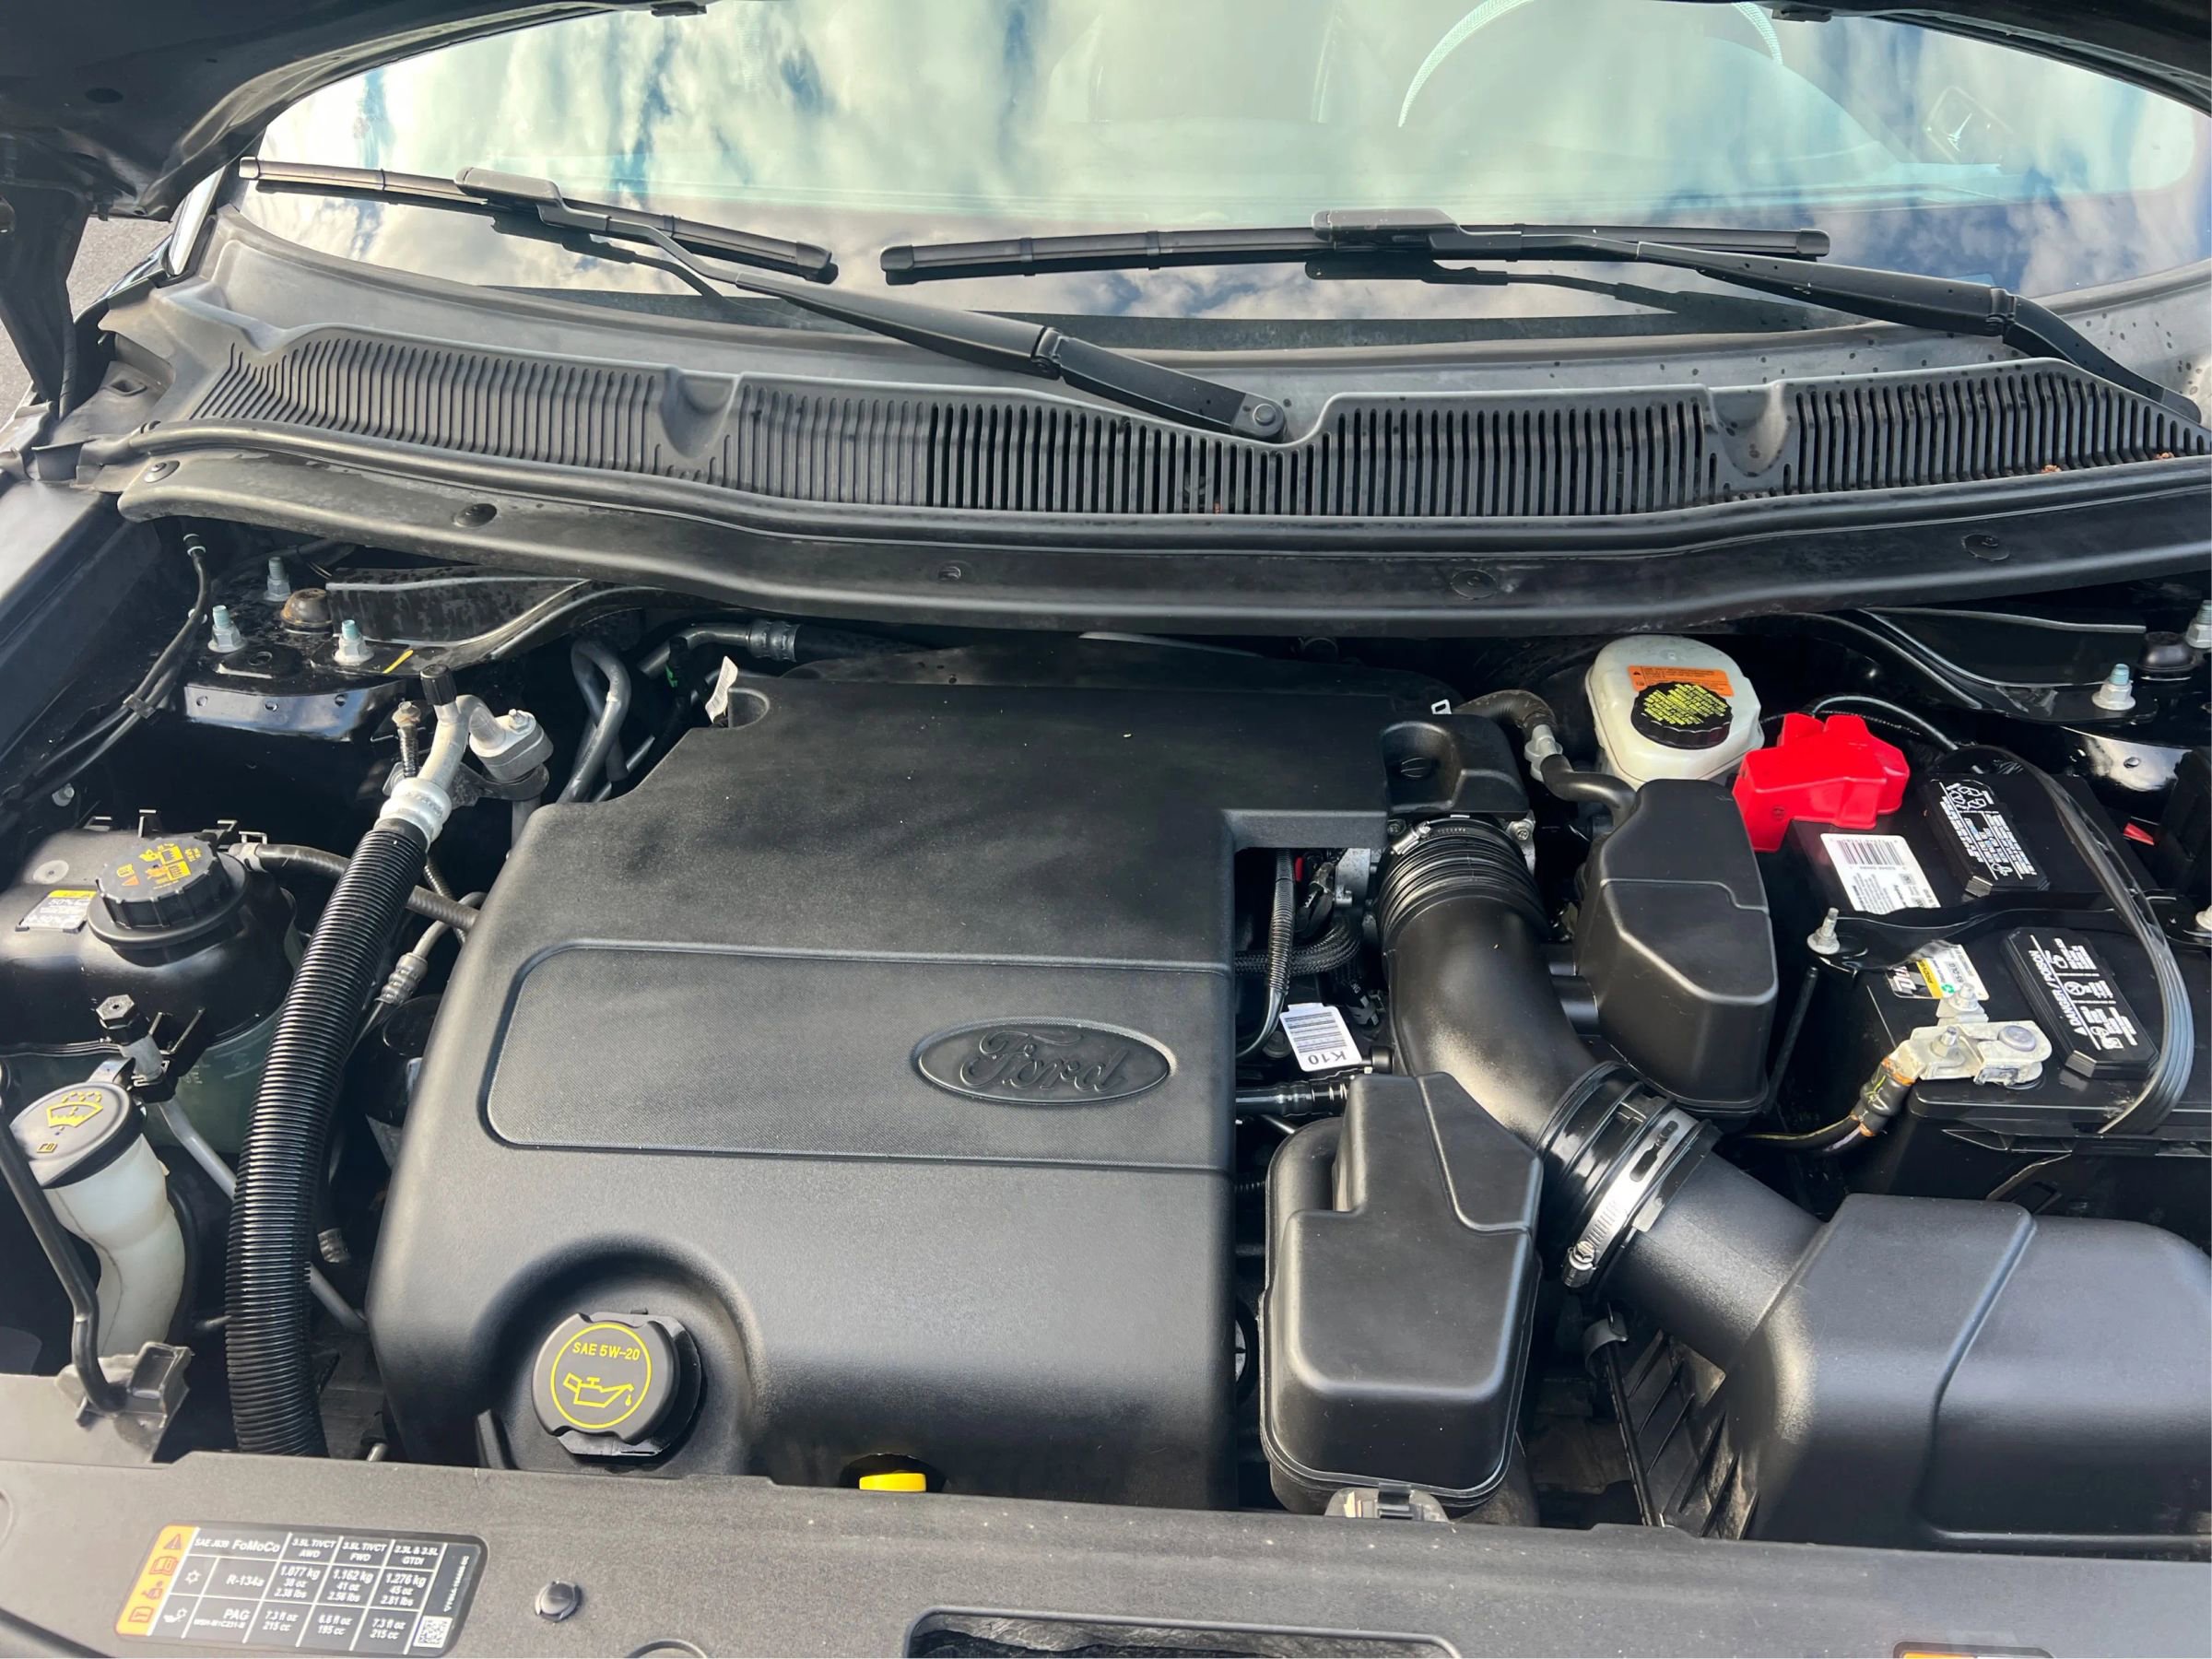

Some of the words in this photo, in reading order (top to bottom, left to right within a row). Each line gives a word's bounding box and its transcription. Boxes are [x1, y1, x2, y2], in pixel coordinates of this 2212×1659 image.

[2029, 950, 2056, 982] POISON
[2052, 989, 2083, 1027] DANGER
[960, 1030, 1130, 1092] Ford
[1308, 1050, 1347, 1065] K10
[572, 1342, 597, 1357] SAE
[599, 1344, 641, 1361] 5W-20
[194, 1538, 212, 1547] SAE
[231, 1539, 281, 1553] FoMoCo
[292, 1538, 310, 1547] 3.5L
[342, 1541, 360, 1550] 3.5L
[298, 1549, 322, 1558] AWD
[349, 1552, 371, 1561] FWD
[280, 1566, 307, 1577] 1.077
[306, 1568, 321, 1581] kg
[333, 1569, 359, 1581] 1.162
[359, 1571, 373, 1584] kg
[226, 1574, 265, 1587] R-134a
[386, 1572, 413, 1584] 1.276
[412, 1574, 427, 1588] kg
[348, 1583, 361, 1592] oz
[401, 1587, 414, 1595] oz
[347, 1592, 360, 1602] lbs
[399, 1596, 414, 1606] lbs
[223, 1608, 251, 1620] PAG
[263, 1621, 280, 1630] 215
[318, 1624, 334, 1634] 195
[334, 1627, 346, 1635] cc
[370, 1629, 387, 1638] 215
[387, 1631, 400, 1640] cc
